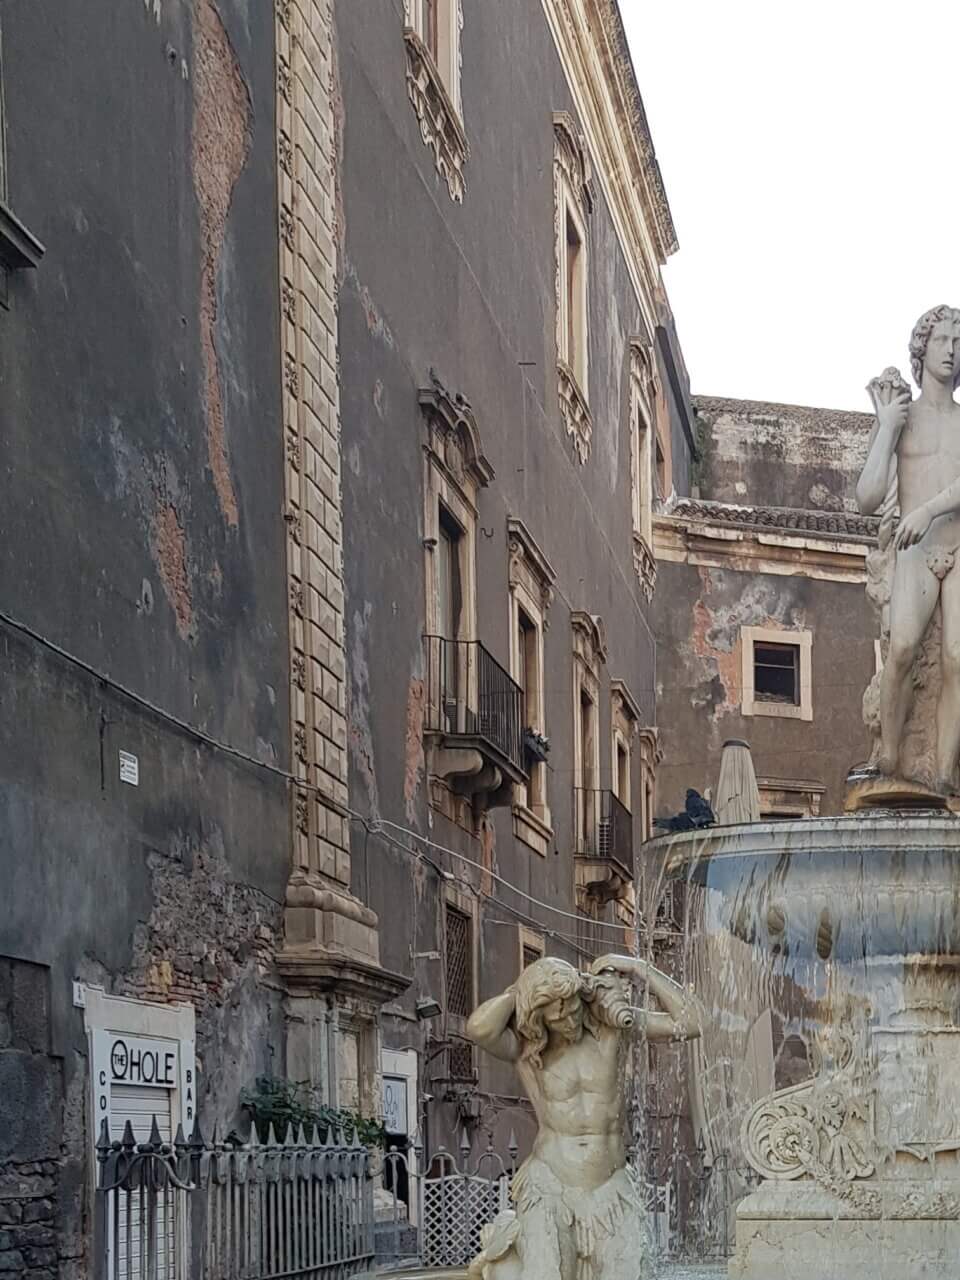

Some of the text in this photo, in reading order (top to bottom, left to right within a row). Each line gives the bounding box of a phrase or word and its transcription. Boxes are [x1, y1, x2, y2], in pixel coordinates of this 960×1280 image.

[113, 1048, 175, 1084] THE HOLE
[186, 1069, 194, 1120] BAR
